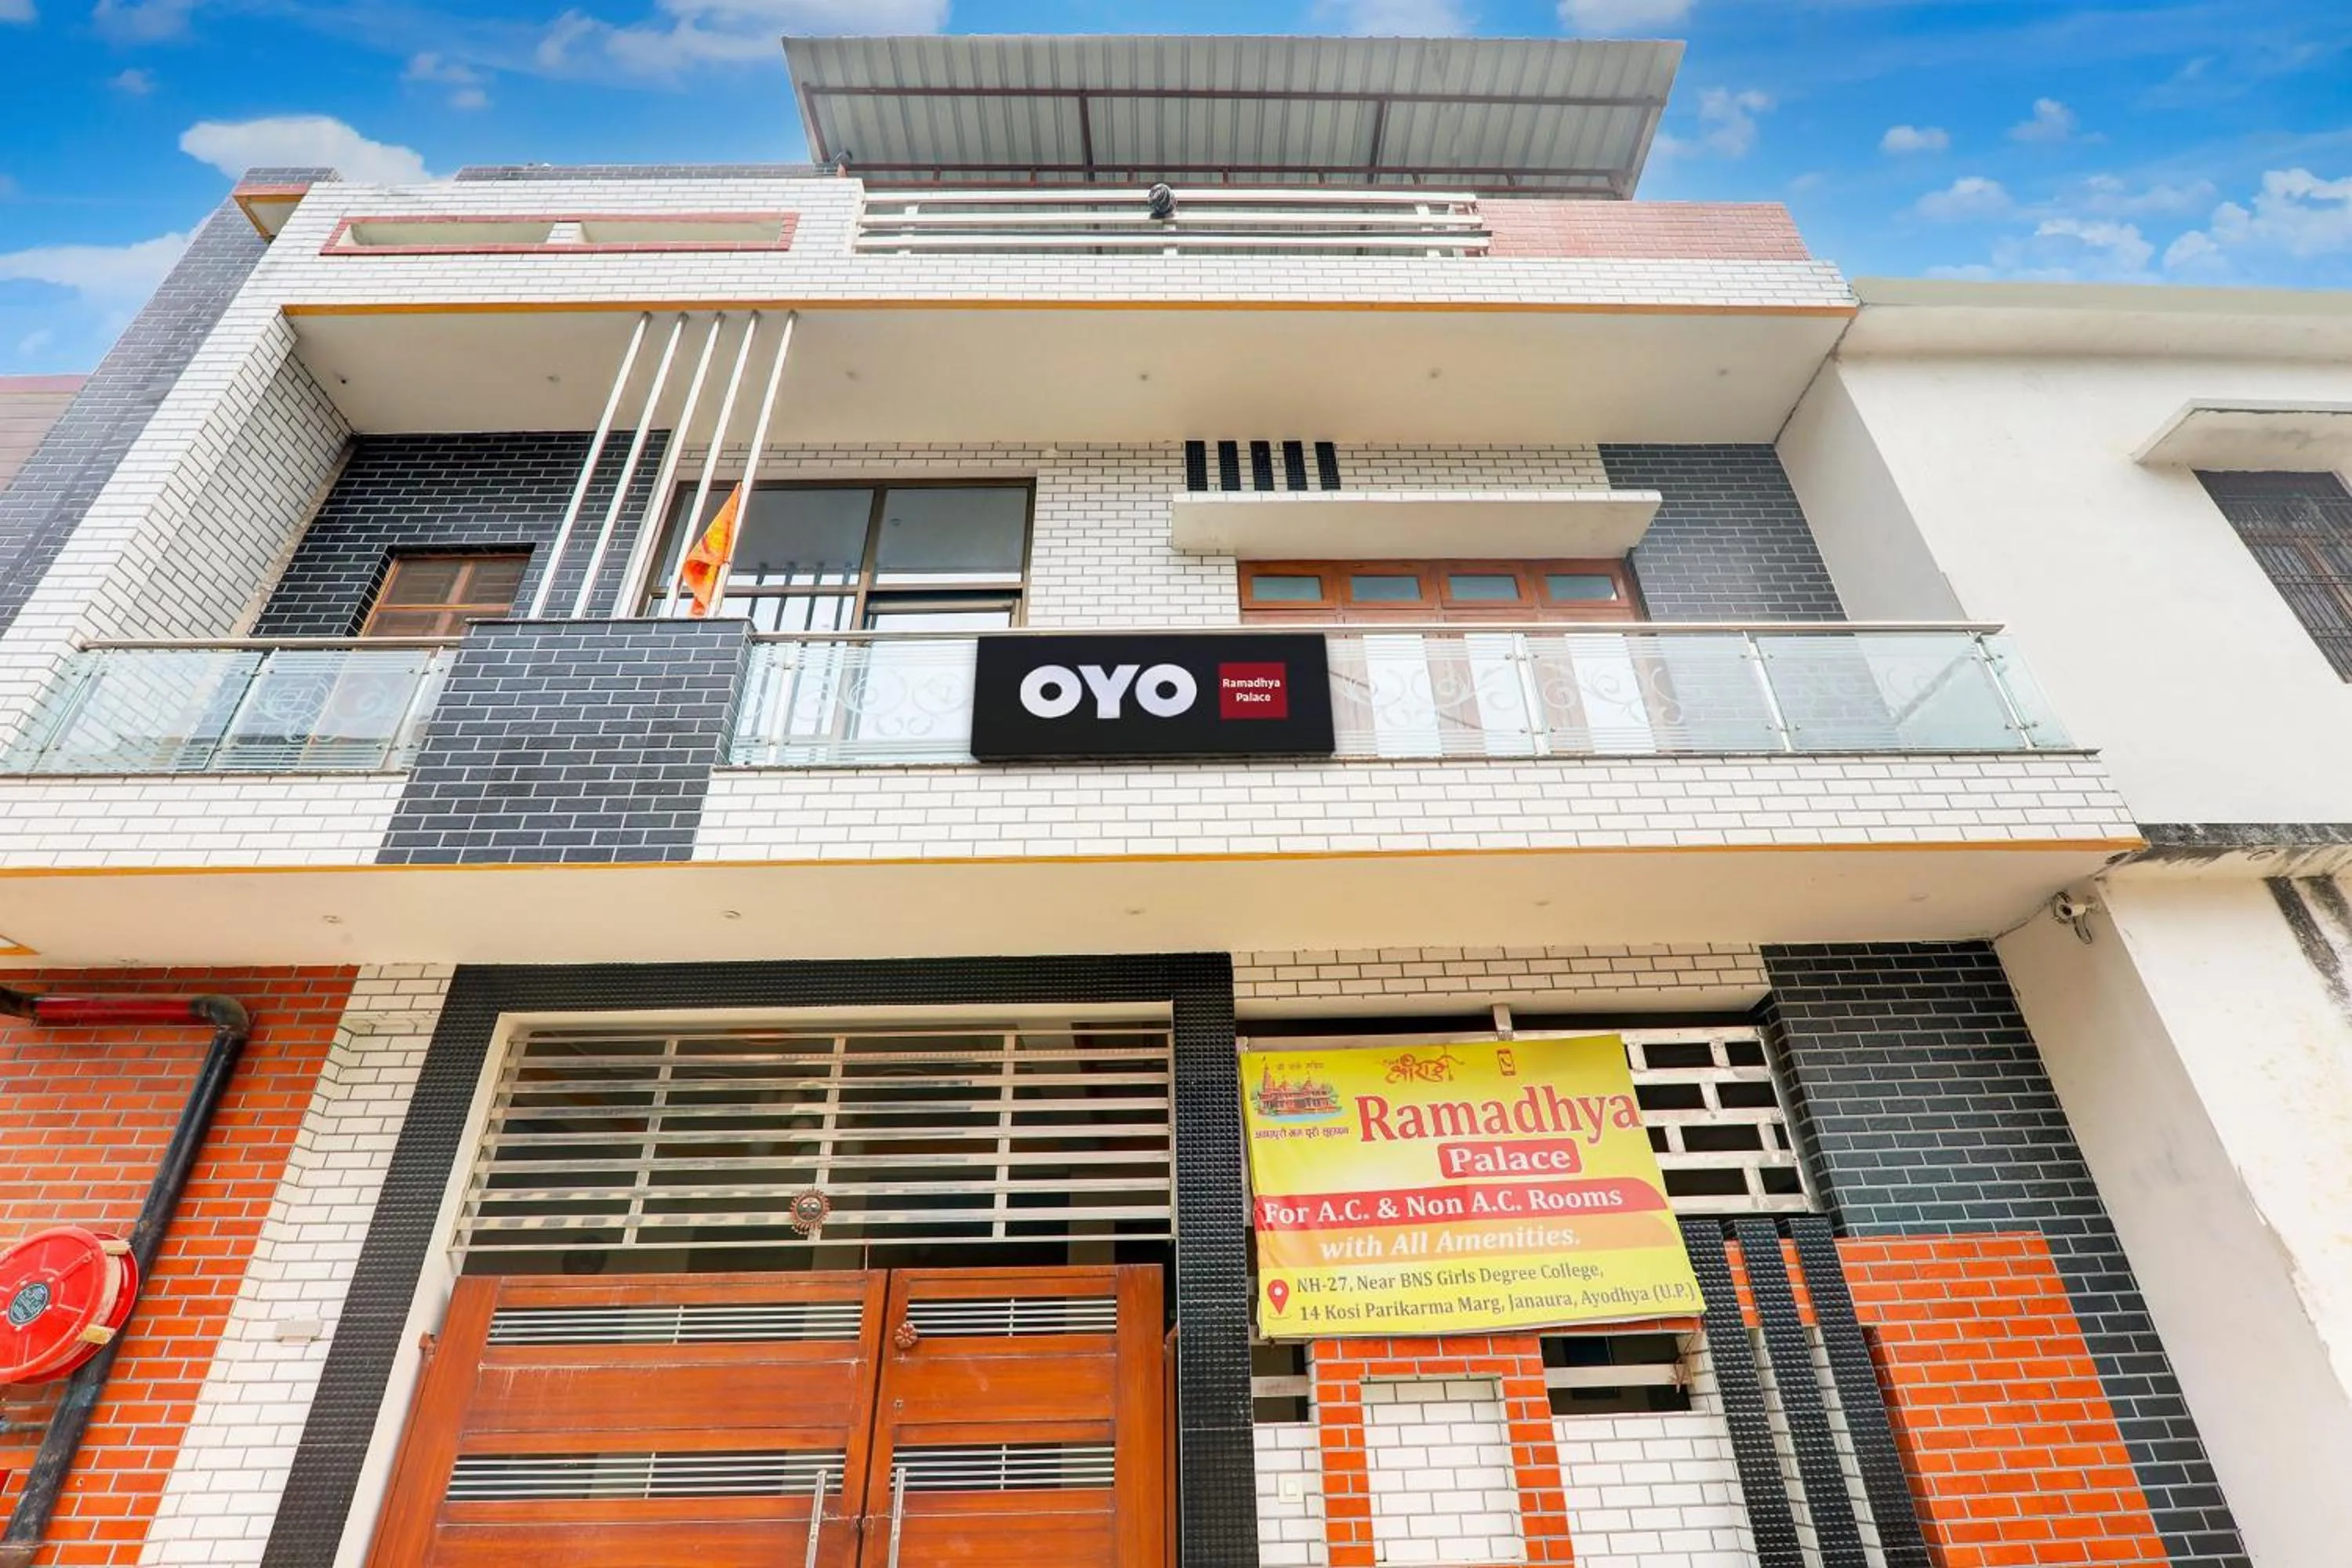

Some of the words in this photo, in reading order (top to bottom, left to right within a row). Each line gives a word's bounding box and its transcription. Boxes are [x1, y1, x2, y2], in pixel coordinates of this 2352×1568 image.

[1020, 664, 1197, 719] OYO
[1222, 677, 1280, 689] Ramadhya
[1236, 691, 1271, 702] Palace
[1355, 1085, 1642, 1143] Ramadhya
[1447, 1145, 1571, 1174] Palace
[1264, 1202, 1310, 1225] For
[1317, 1199, 1370, 1222] A.C.
[1377, 1197, 1399, 1220] &
[1406, 1196, 1465, 1217] Non
[1471, 1190, 1522, 1212] A.C.
[1527, 1189, 1623, 1210] Rooms
[1320, 1234, 1383, 1261] with
[1390, 1230, 1428, 1255] All
[1435, 1225, 1581, 1253] Amenities.
[1297, 1276, 1353, 1294] NH-27,
[1357, 1275, 1396, 1291] Near
[1400, 1271, 1432, 1288] BNS
[1437, 1268, 1475, 1286] Girls
[1480, 1267, 1537, 1286] Degree
[1541, 1263, 1604, 1281] College,
[1301, 1305, 1320, 1321] 14
[1325, 1302, 1361, 1319] Kosi
[1365, 1300, 1454, 1319] Parikarma
[1458, 1294, 1505, 1313] Marg,
[1508, 1292, 1577, 1312] Janaura,
[1581, 1286, 1650, 1308] Ayodhya
[1653, 1282, 1696, 1302] (U.P.)
